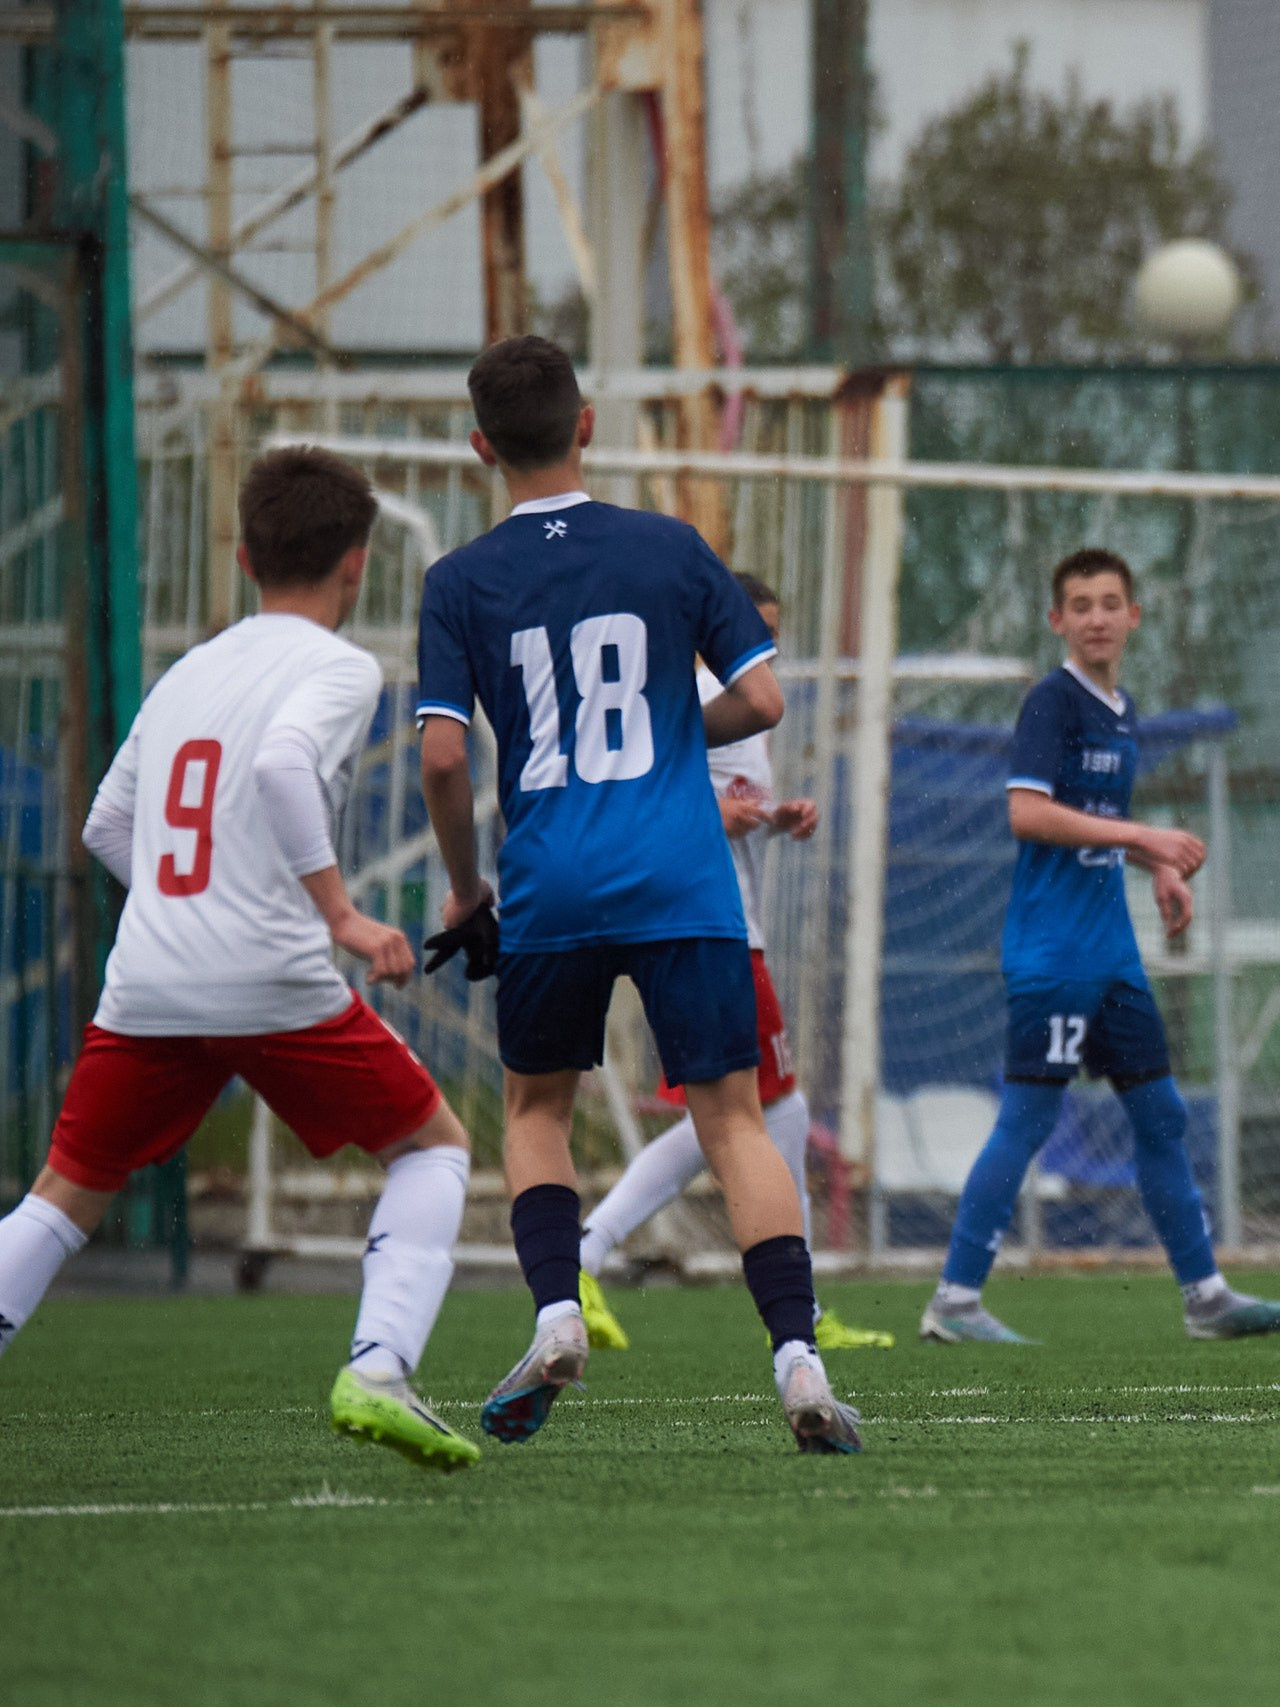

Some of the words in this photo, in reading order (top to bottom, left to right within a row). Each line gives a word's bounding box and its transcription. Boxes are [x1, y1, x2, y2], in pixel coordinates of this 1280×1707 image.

[510, 612, 654, 792] 18
[157, 739, 222, 896] 9
[1046, 1014, 1085, 1064] 12
